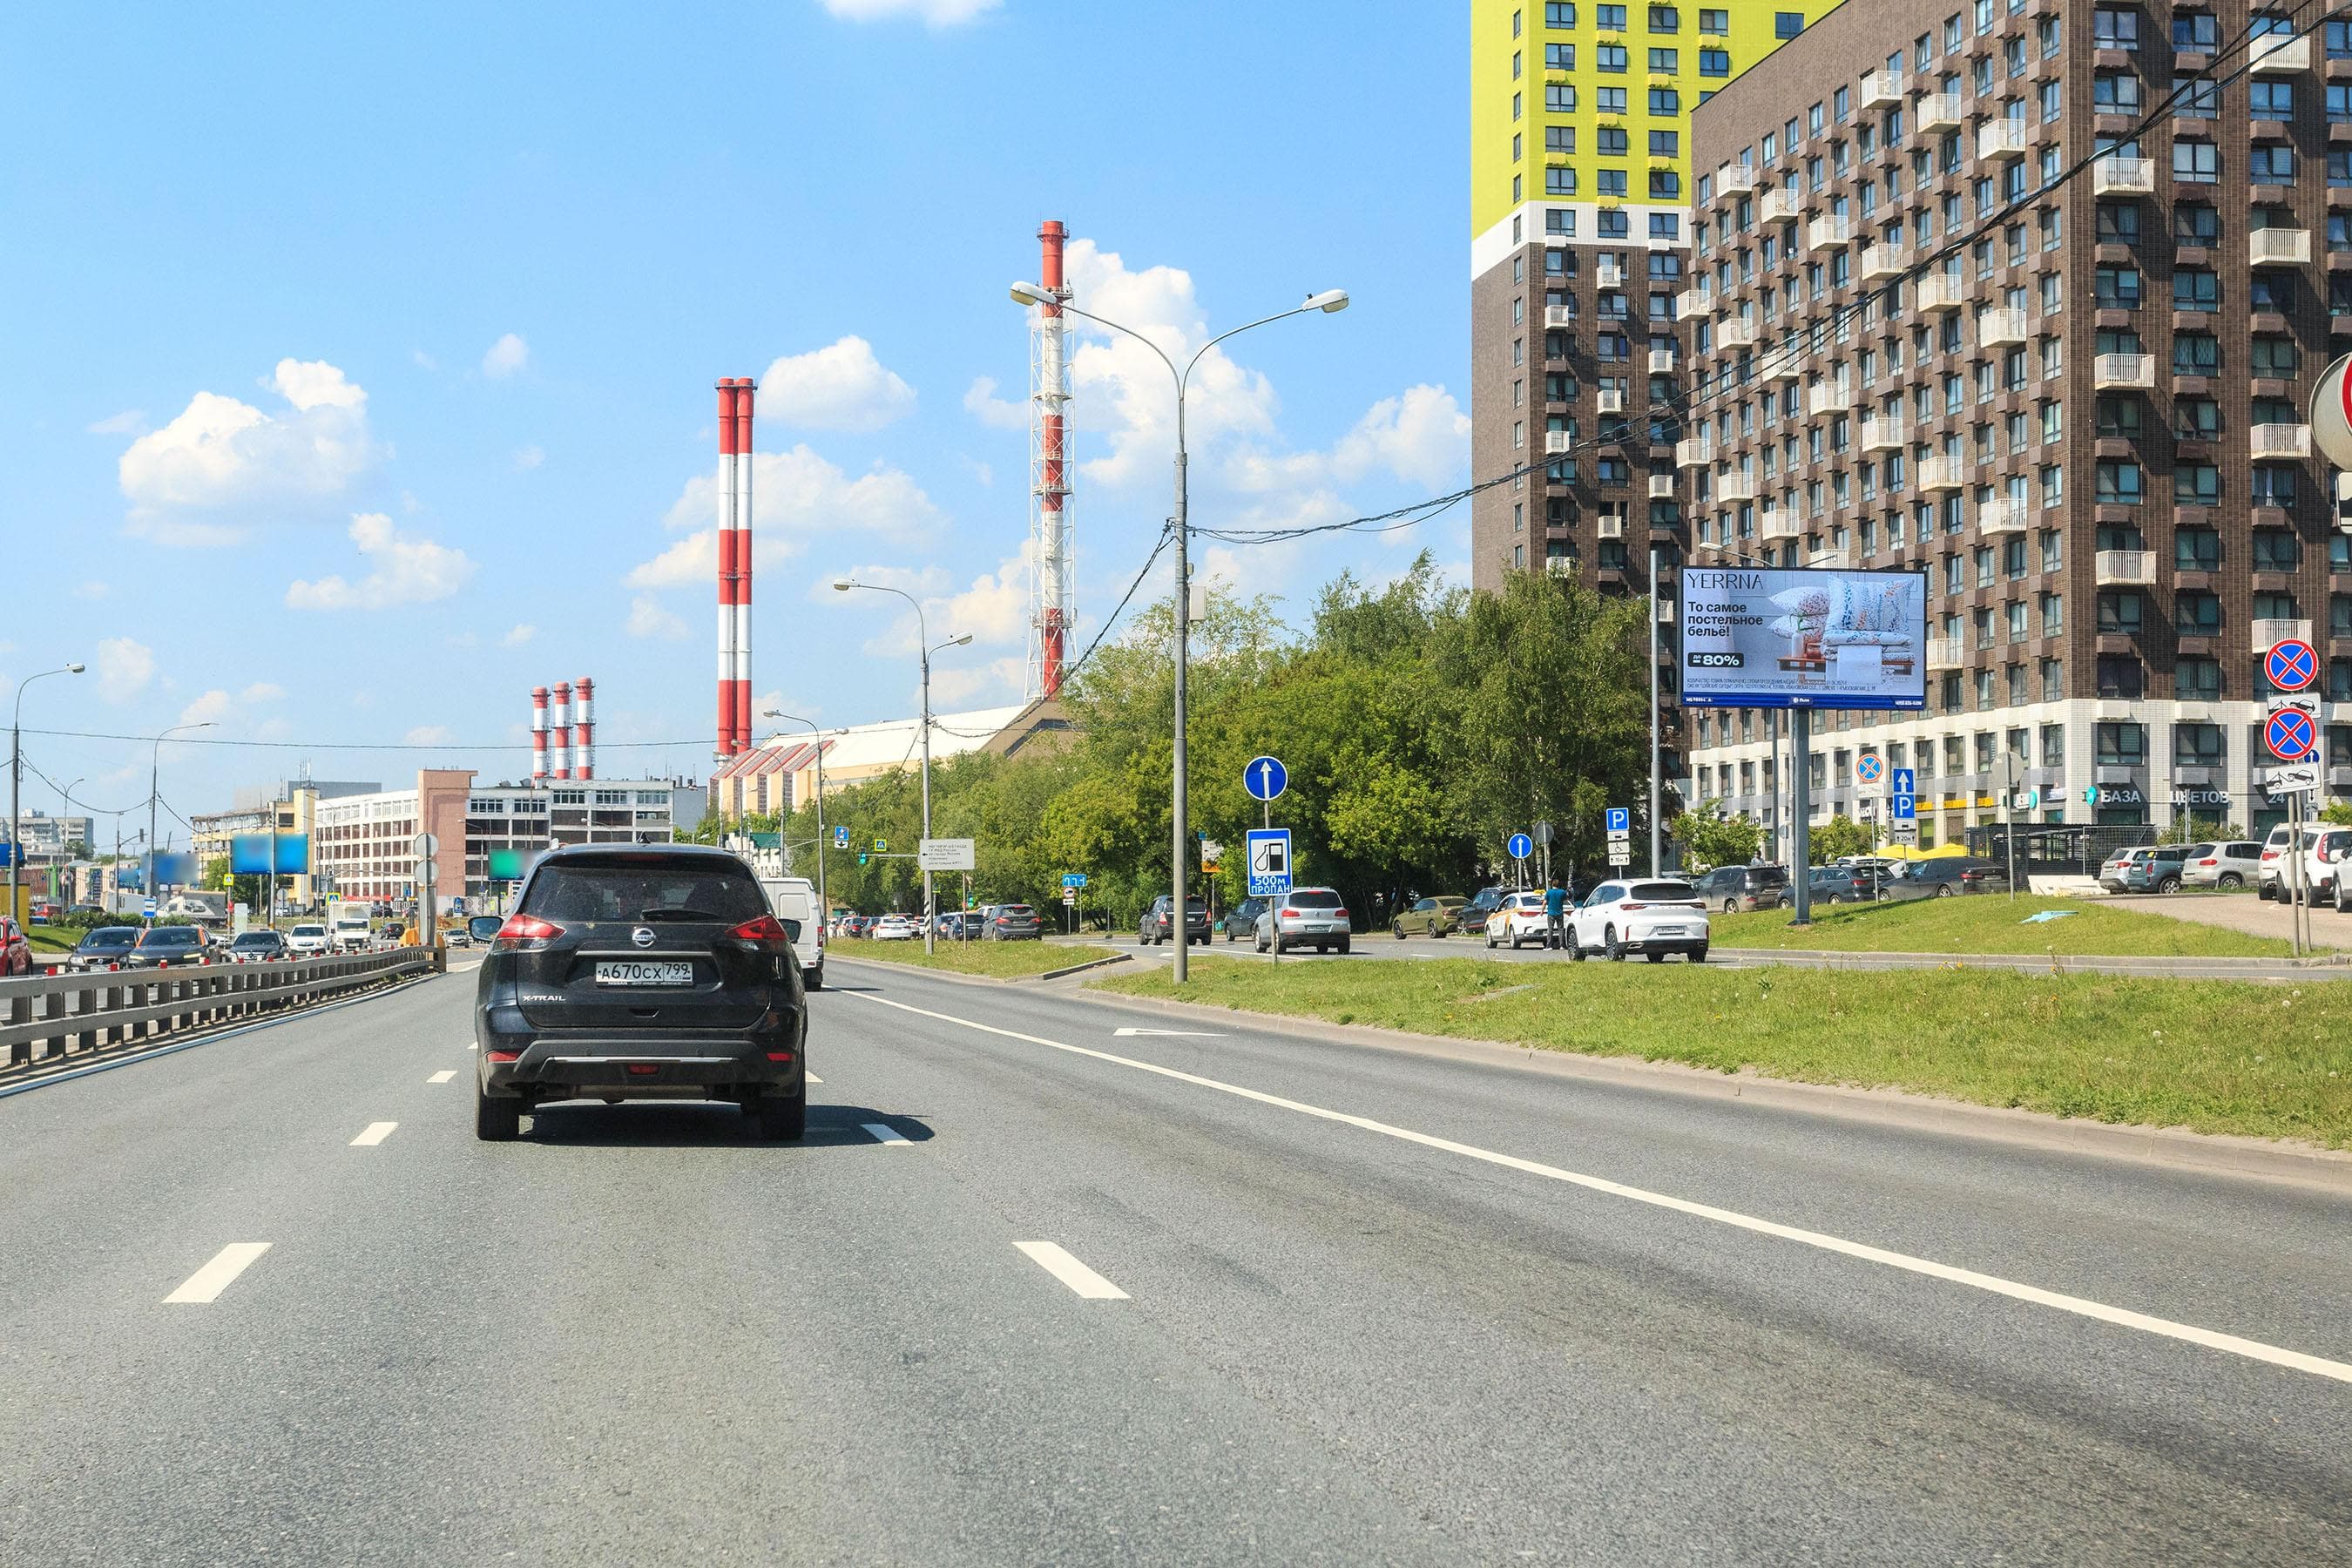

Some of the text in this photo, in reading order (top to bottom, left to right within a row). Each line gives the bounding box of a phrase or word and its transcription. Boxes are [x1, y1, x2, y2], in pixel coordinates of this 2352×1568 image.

[1687, 572, 1764, 590] YERRNA
[1687, 601, 1747, 613] То самое
[1687, 615, 1764, 625] постельное
[1687, 625, 1730, 637] бельё!
[2100, 789, 2141, 803] БАЗА
[2170, 789, 2230, 806] ЦВЕТОВ
[2268, 793, 2286, 804] 24
[1255, 875, 1286, 886] 500м
[1251, 885, 1290, 895] ПРОПАН
[665, 963, 688, 975] 799
